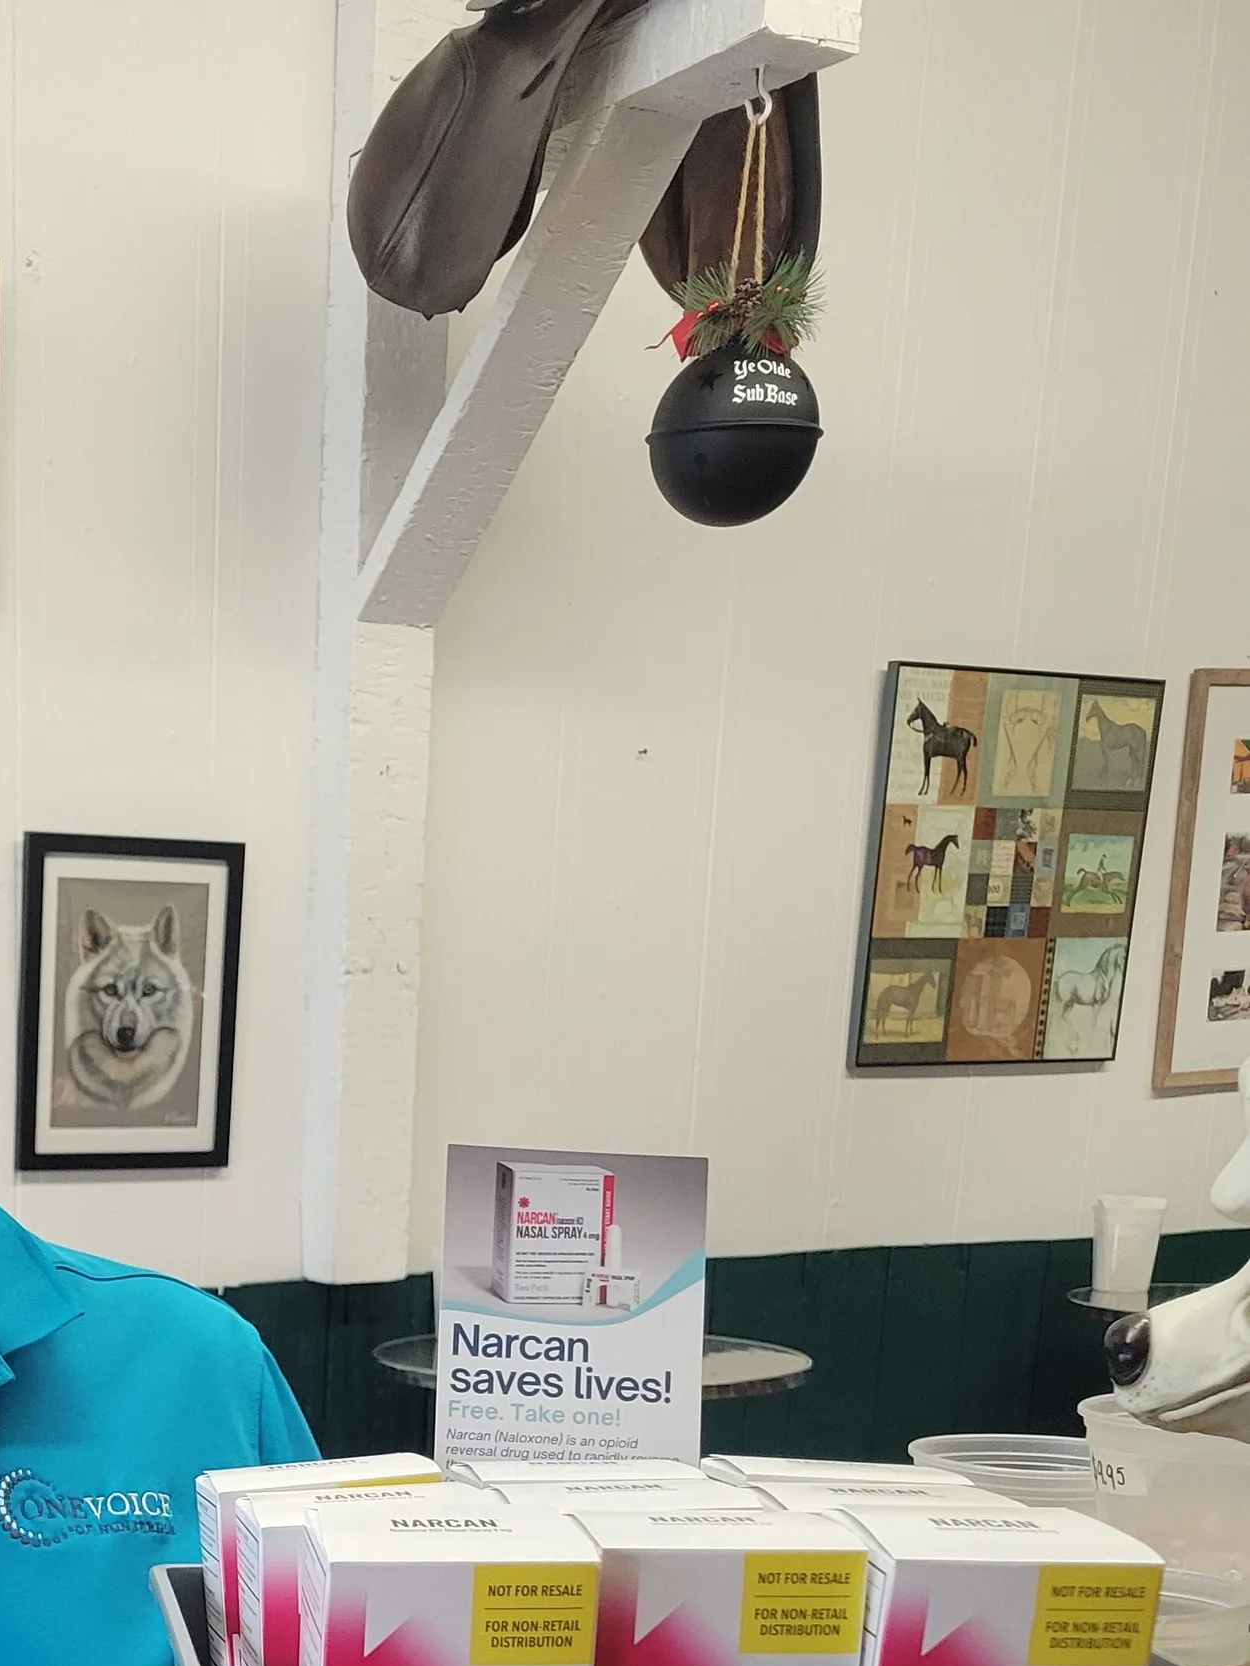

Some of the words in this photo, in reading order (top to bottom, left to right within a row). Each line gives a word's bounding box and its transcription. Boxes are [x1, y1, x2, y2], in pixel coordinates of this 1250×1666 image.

[733, 359, 757, 381] Ye
[757, 358, 792, 379] Olde
[516, 1211, 556, 1225] NARCAN
[516, 1225, 549, 1239] NASAL
[551, 1226, 583, 1240] SPRAY
[451, 1322, 589, 1363] Narcan
[449, 1366, 564, 1399] saves
[574, 1366, 672, 1404] lives!
[448, 1399, 503, 1421] Free.
[510, 1403, 565, 1424] Take
[572, 1408, 621, 1427] one!
[446, 1428, 491, 1442] Narcan
[494, 1430, 563, 1447] (Naloxone)
[566, 1434, 576, 1446] is
[579, 1437, 595, 1447] an
[598, 1438, 639, 1451] opioid
[445, 1445, 498, 1457] reversal
[500, 1447, 530, 1462] drug
[533, 1448, 564, 1461] used
[568, 1450, 581, 1461] to
[315, 1490, 413, 1501] NARCAN
[390, 1518, 499, 1528] NARCAN
[928, 1517, 1040, 1529] NARCAN
[757, 1572, 781, 1584] NOT
[784, 1572, 807, 1584] FOR
[810, 1572, 851, 1584] RESALE
[488, 1584, 512, 1596] NOT
[515, 1584, 538, 1596] FOR
[541, 1584, 583, 1596] RESALE
[754, 1608, 777, 1620] FOR
[780, 1608, 848, 1620] NON-RETAIL
[485, 1620, 509, 1632] FOR
[511, 1620, 581, 1632] NON-RETAIL
[760, 1624, 841, 1636] DISTRIBUTION
[491, 1636, 573, 1648] DISTRIBUTION
